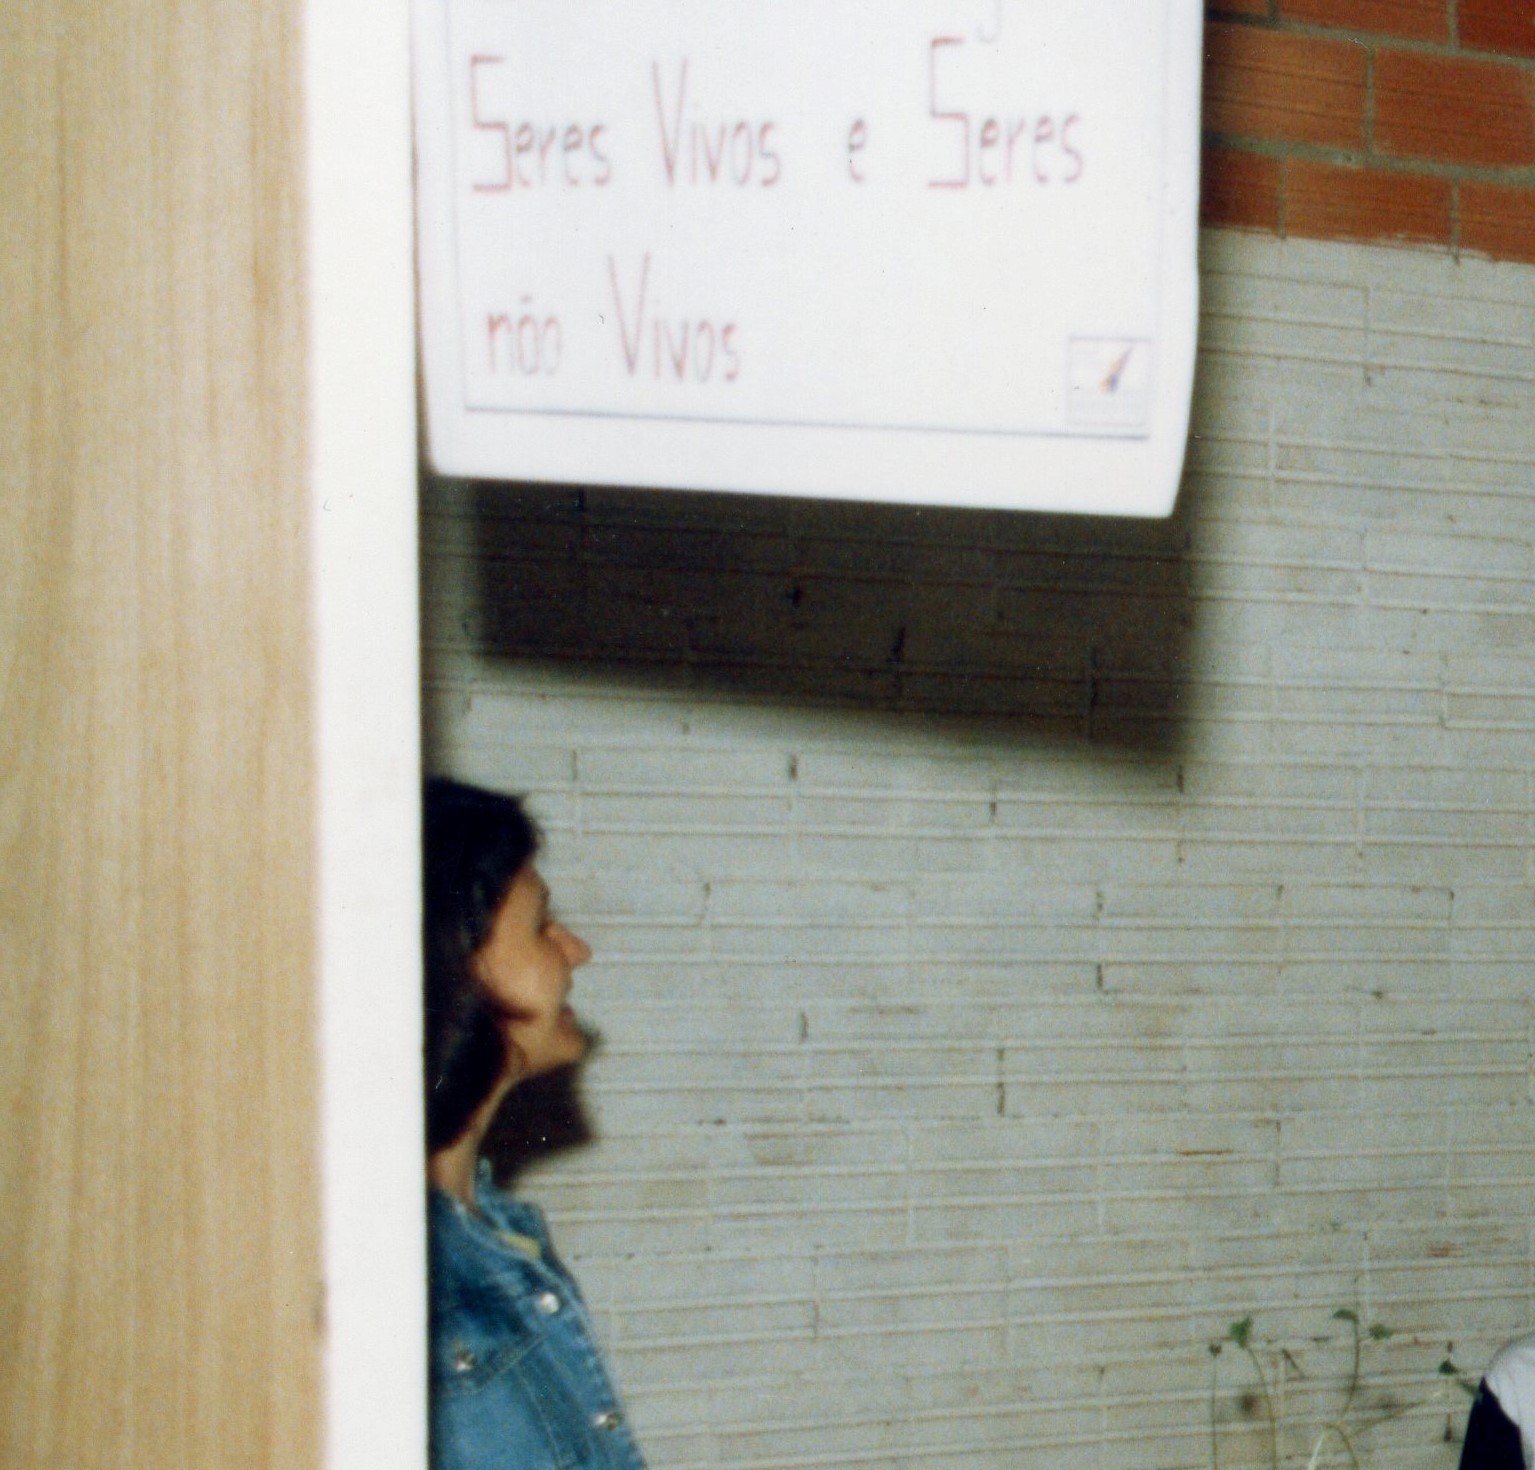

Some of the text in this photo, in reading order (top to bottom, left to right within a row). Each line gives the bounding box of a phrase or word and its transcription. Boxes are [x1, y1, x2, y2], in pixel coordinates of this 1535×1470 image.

[470, 37, 1085, 193] Seres Vivos e Seres
[608, 253, 743, 384] Vivos
